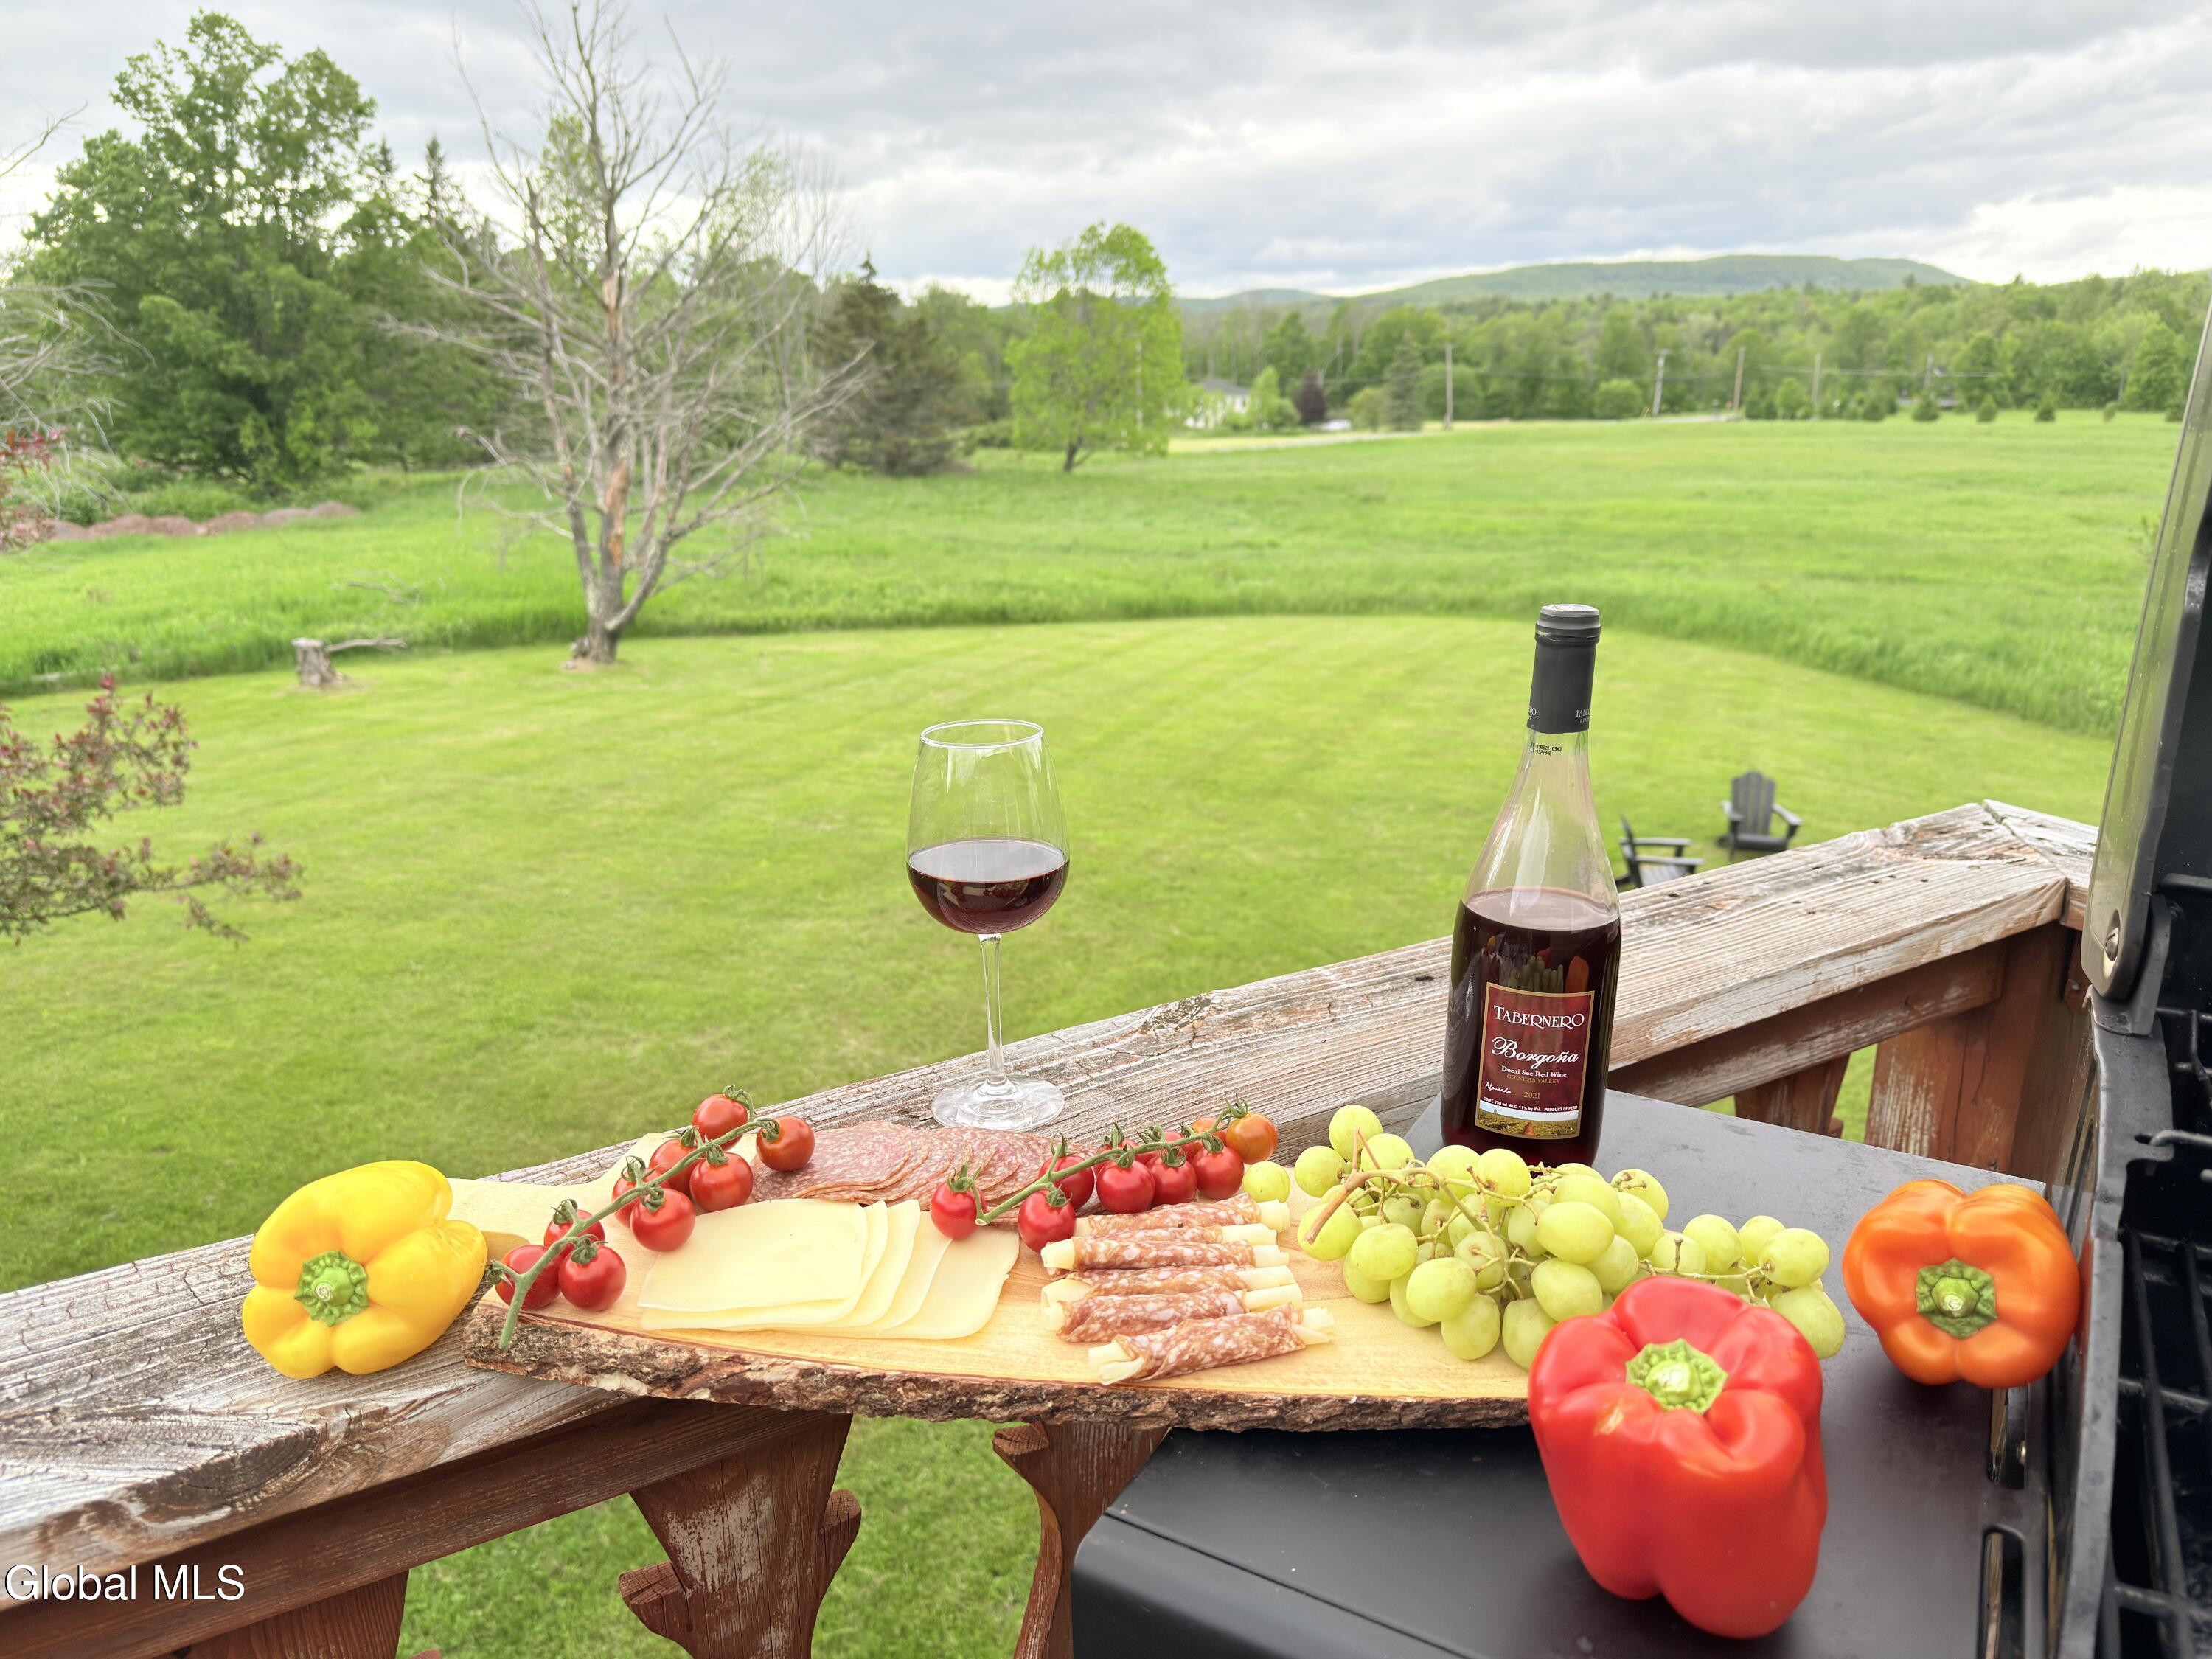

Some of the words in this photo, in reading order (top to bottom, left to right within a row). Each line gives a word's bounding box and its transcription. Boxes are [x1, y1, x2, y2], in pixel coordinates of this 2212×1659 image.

[1493, 1005, 1585, 1029] TABERNERO
[1491, 1037, 1579, 1069] Borgoña
[1501, 1065, 1520, 1074] Demi
[1506, 1074, 1536, 1083] CHINCHA
[1523, 1091, 1541, 1099] 2021
